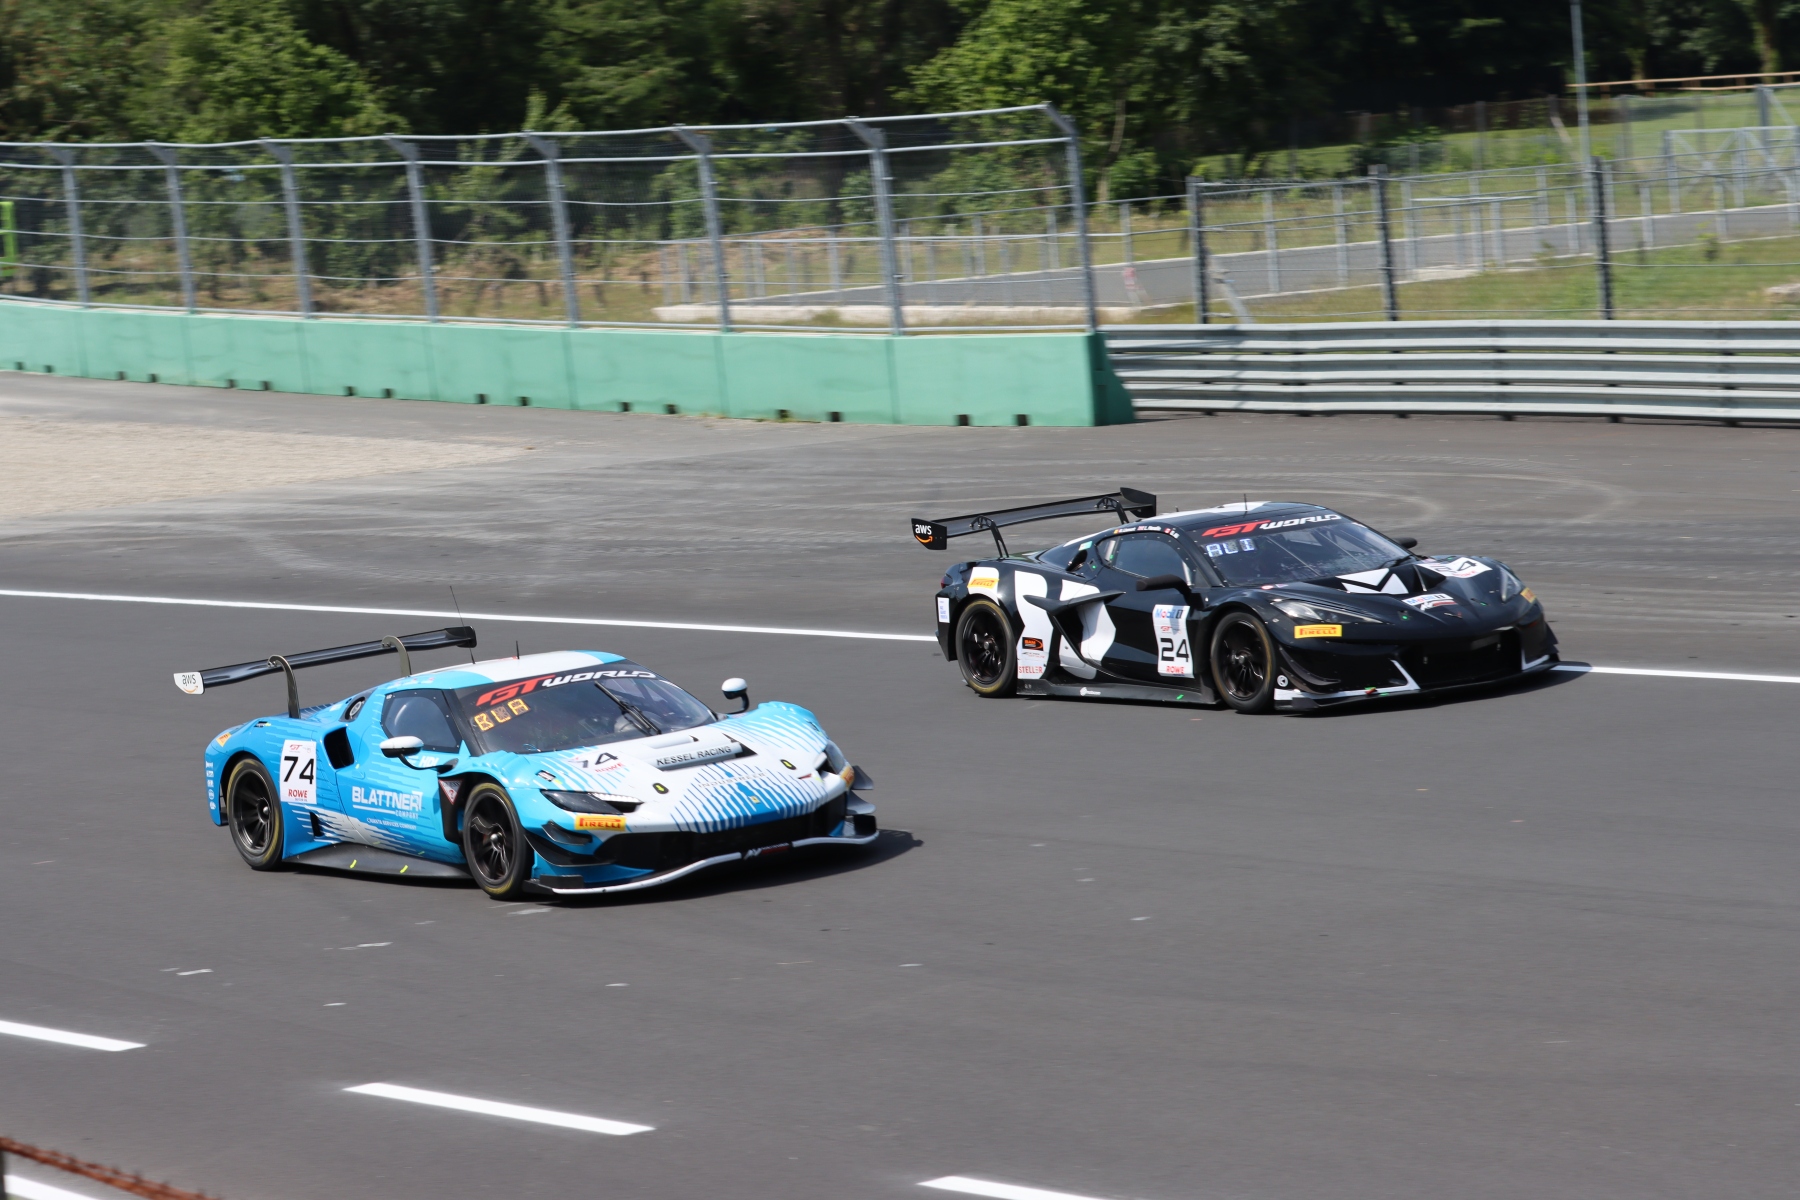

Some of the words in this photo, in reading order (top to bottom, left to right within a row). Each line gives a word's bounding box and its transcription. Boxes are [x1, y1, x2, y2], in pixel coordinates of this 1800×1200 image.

[915, 524, 932, 535] aws
[1202, 520, 1271, 537] GT
[1206, 538, 1255, 558] ALI
[1300, 626, 1337, 636] PIRELLI
[1160, 637, 1190, 663] 24
[182, 674, 197, 687] aws
[476, 675, 556, 707] GT
[474, 698, 530, 732] BLA
[656, 752, 696, 766] KESSEL
[697, 745, 732, 759] RACING
[283, 755, 315, 785] 74
[288, 788, 308, 799] ROWE
[352, 785, 424, 812] BLATTNER
[579, 817, 621, 829] PIRELLI
